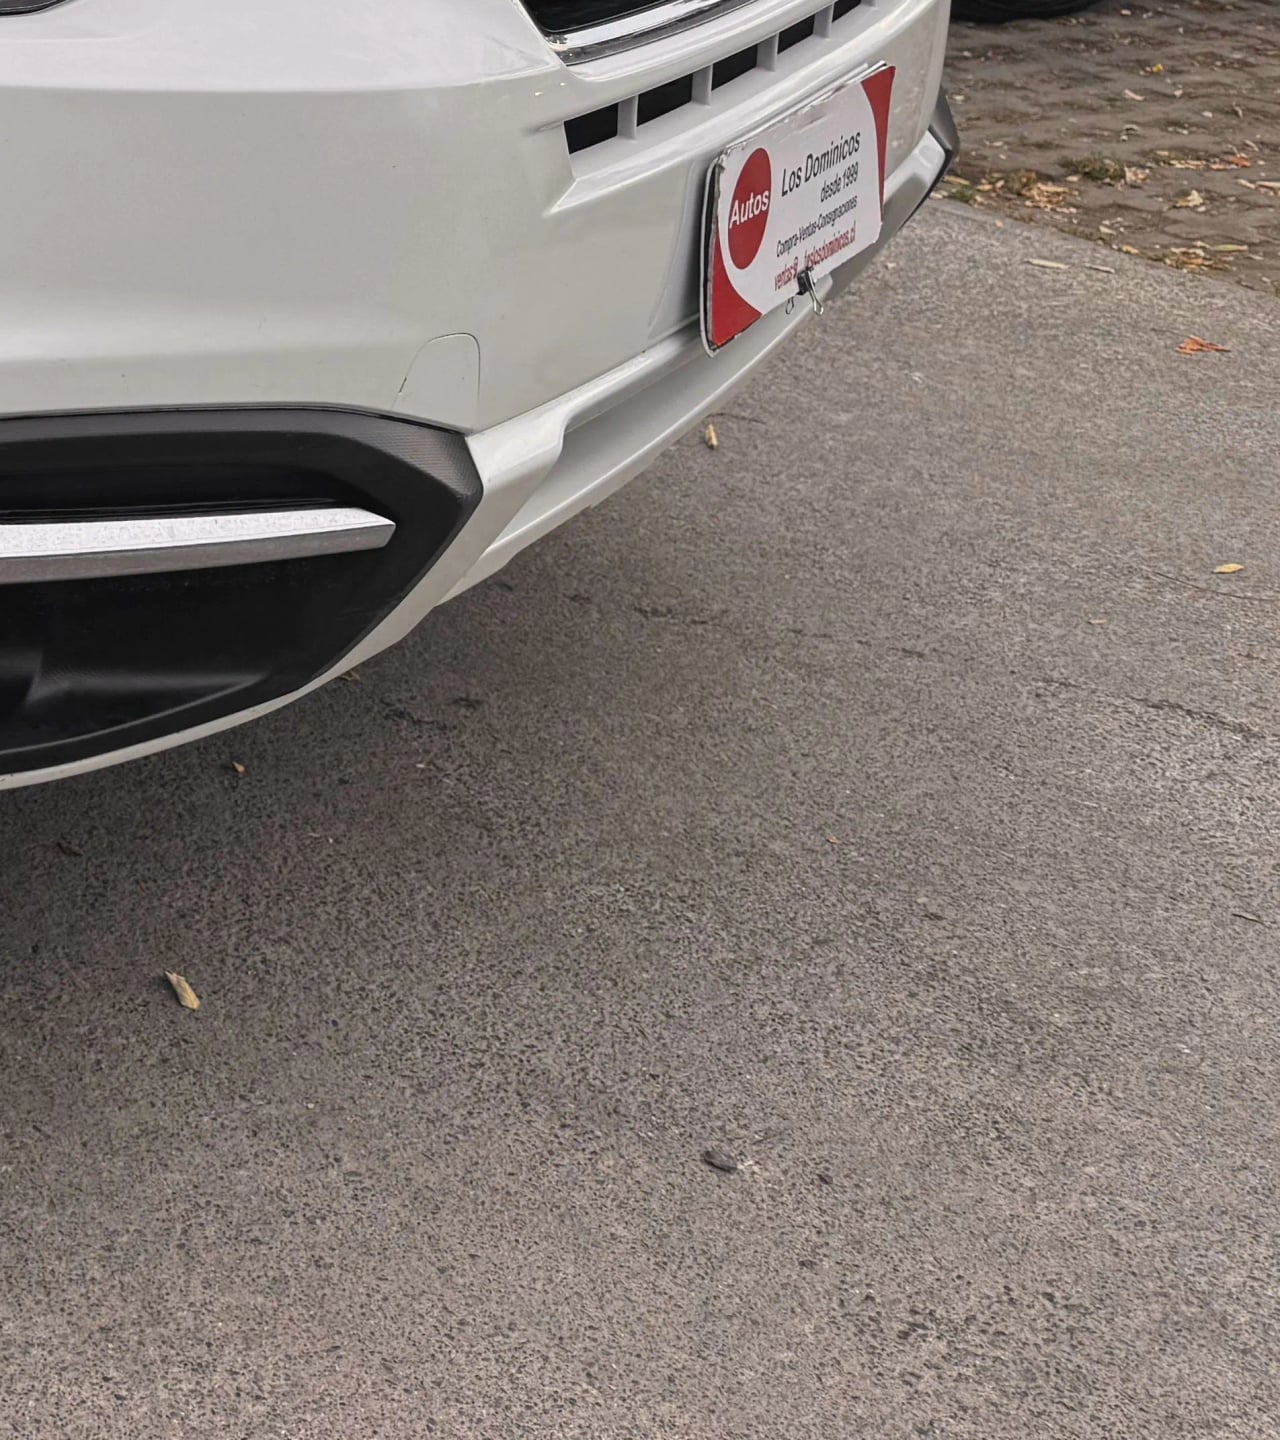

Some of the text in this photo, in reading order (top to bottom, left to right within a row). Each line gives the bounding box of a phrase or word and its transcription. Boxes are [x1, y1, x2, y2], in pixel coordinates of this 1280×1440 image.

[781, 131, 861, 197] Los Dominicos
[820, 161, 859, 203] desde 1999
[729, 189, 769, 229] Autos
